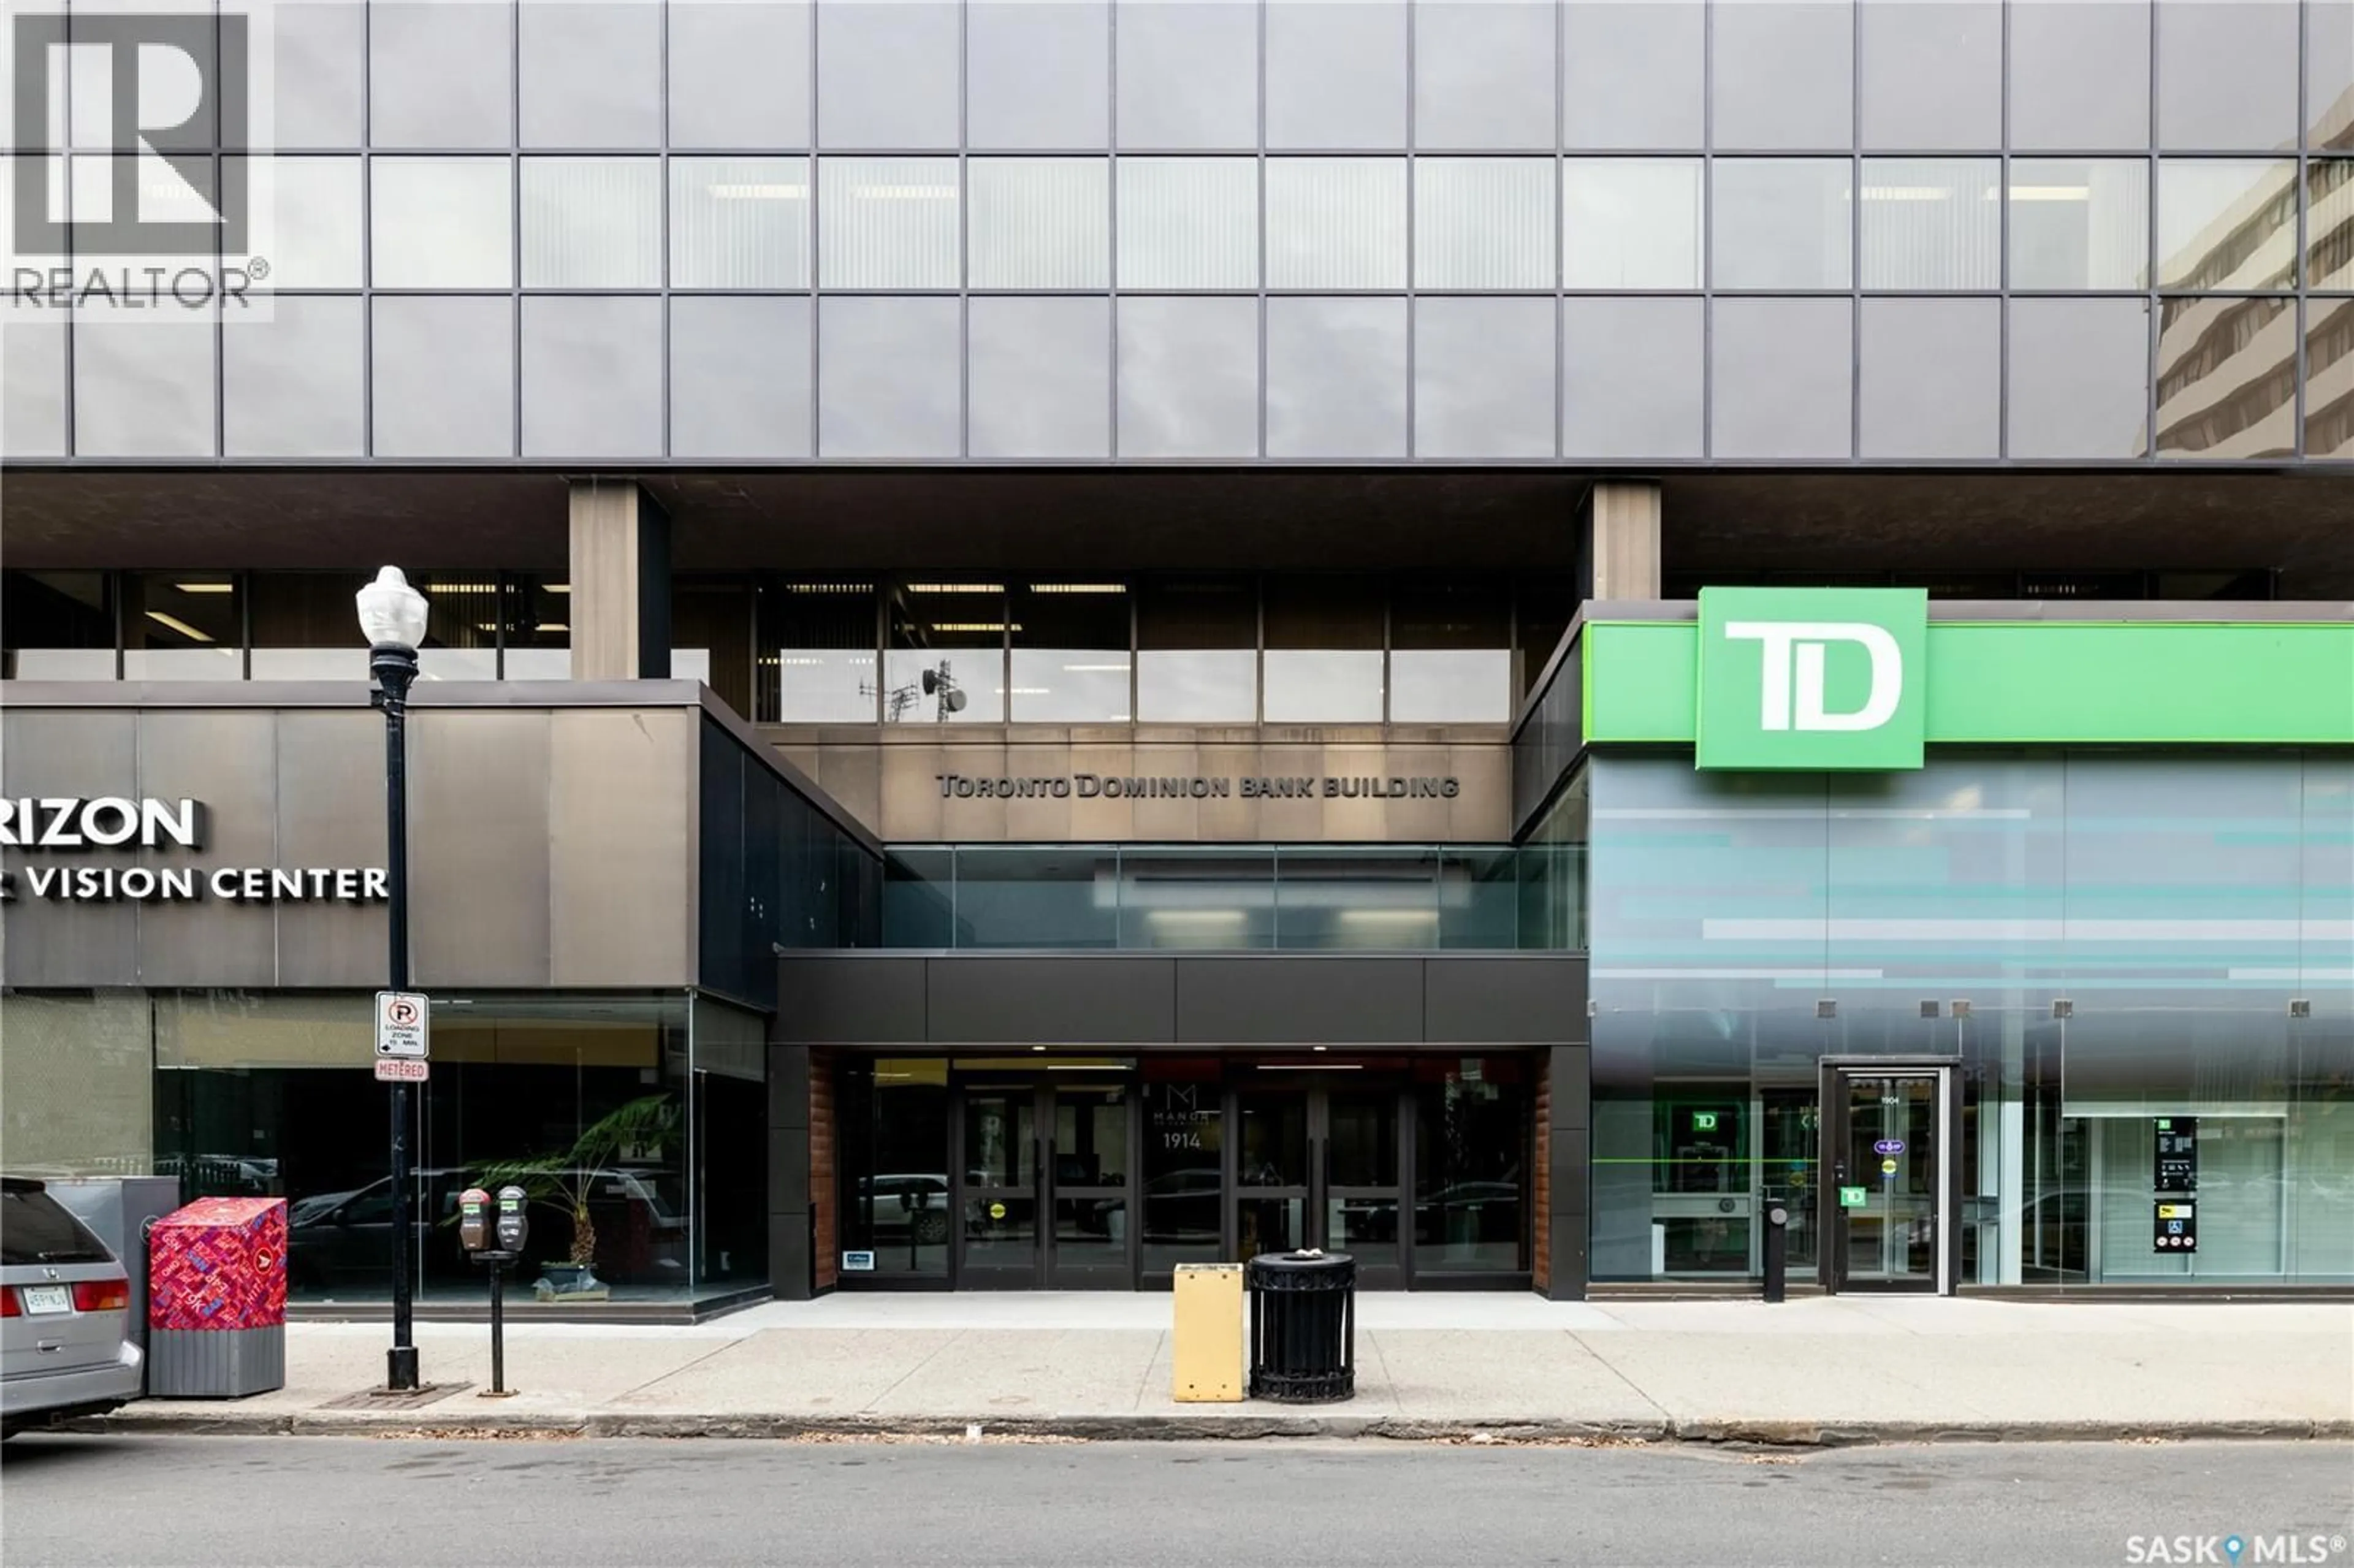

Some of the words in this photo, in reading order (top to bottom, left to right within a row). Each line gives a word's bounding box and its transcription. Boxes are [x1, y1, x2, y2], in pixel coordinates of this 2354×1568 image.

[1725, 622, 1903, 731] TD
[935, 775, 1070, 797] TORONTO
[1074, 774, 1230, 797] DOMINION
[1240, 777, 1315, 798] BANK
[1322, 777, 1460, 798] BUILDING
[25, 866, 193, 898] VISION
[210, 867, 389, 898] CENTER
[379, 1062, 425, 1077] METERED
[1694, 1114, 1715, 1128] TD
[1163, 1132, 1201, 1149] 1914
